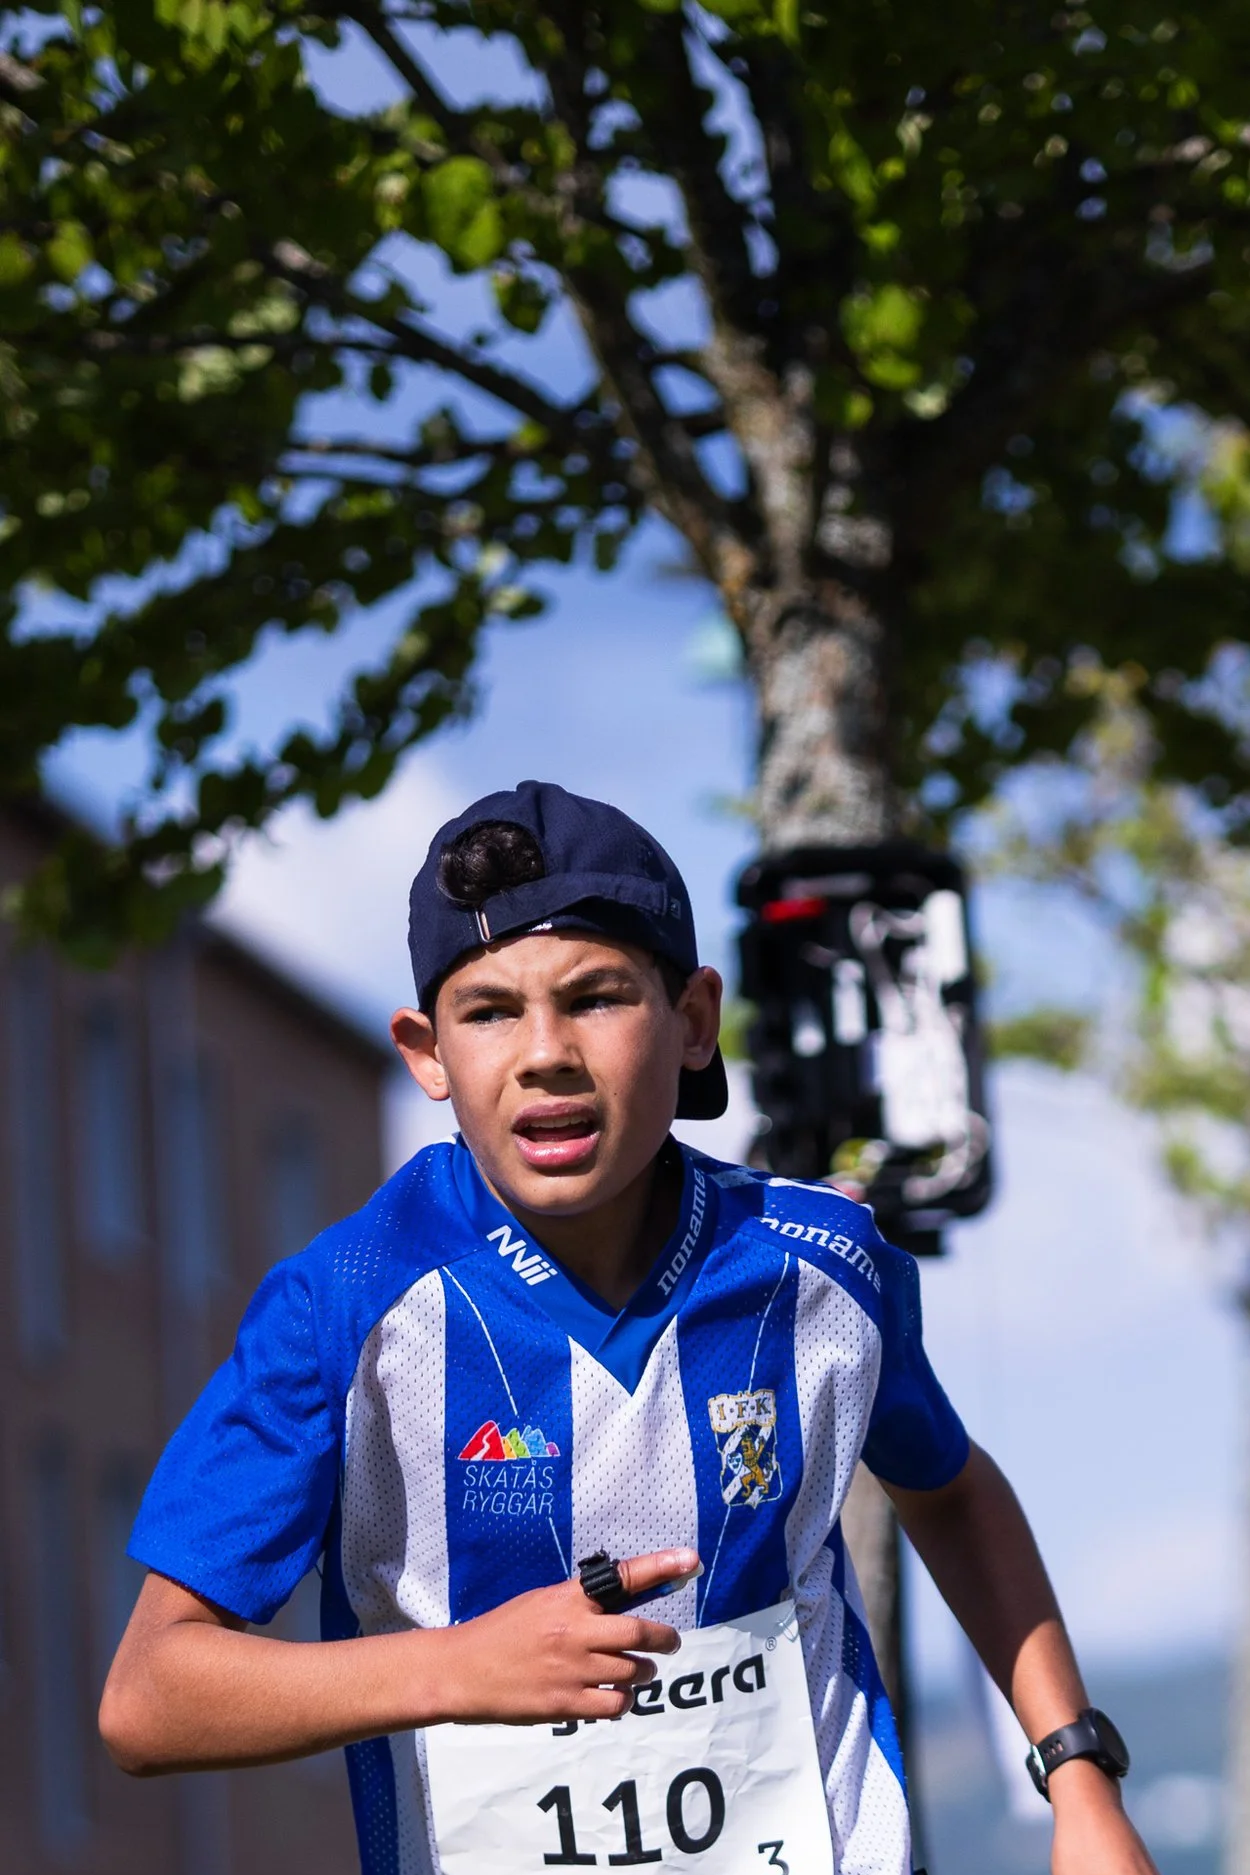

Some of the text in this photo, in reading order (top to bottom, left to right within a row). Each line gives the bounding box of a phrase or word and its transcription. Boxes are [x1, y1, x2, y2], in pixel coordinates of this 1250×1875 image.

[656, 1168, 707, 1297] noname
[462, 1489, 555, 1516] RYGGAR
[463, 1459, 555, 1490] SKATÅS
[536, 1766, 726, 1867] 110
